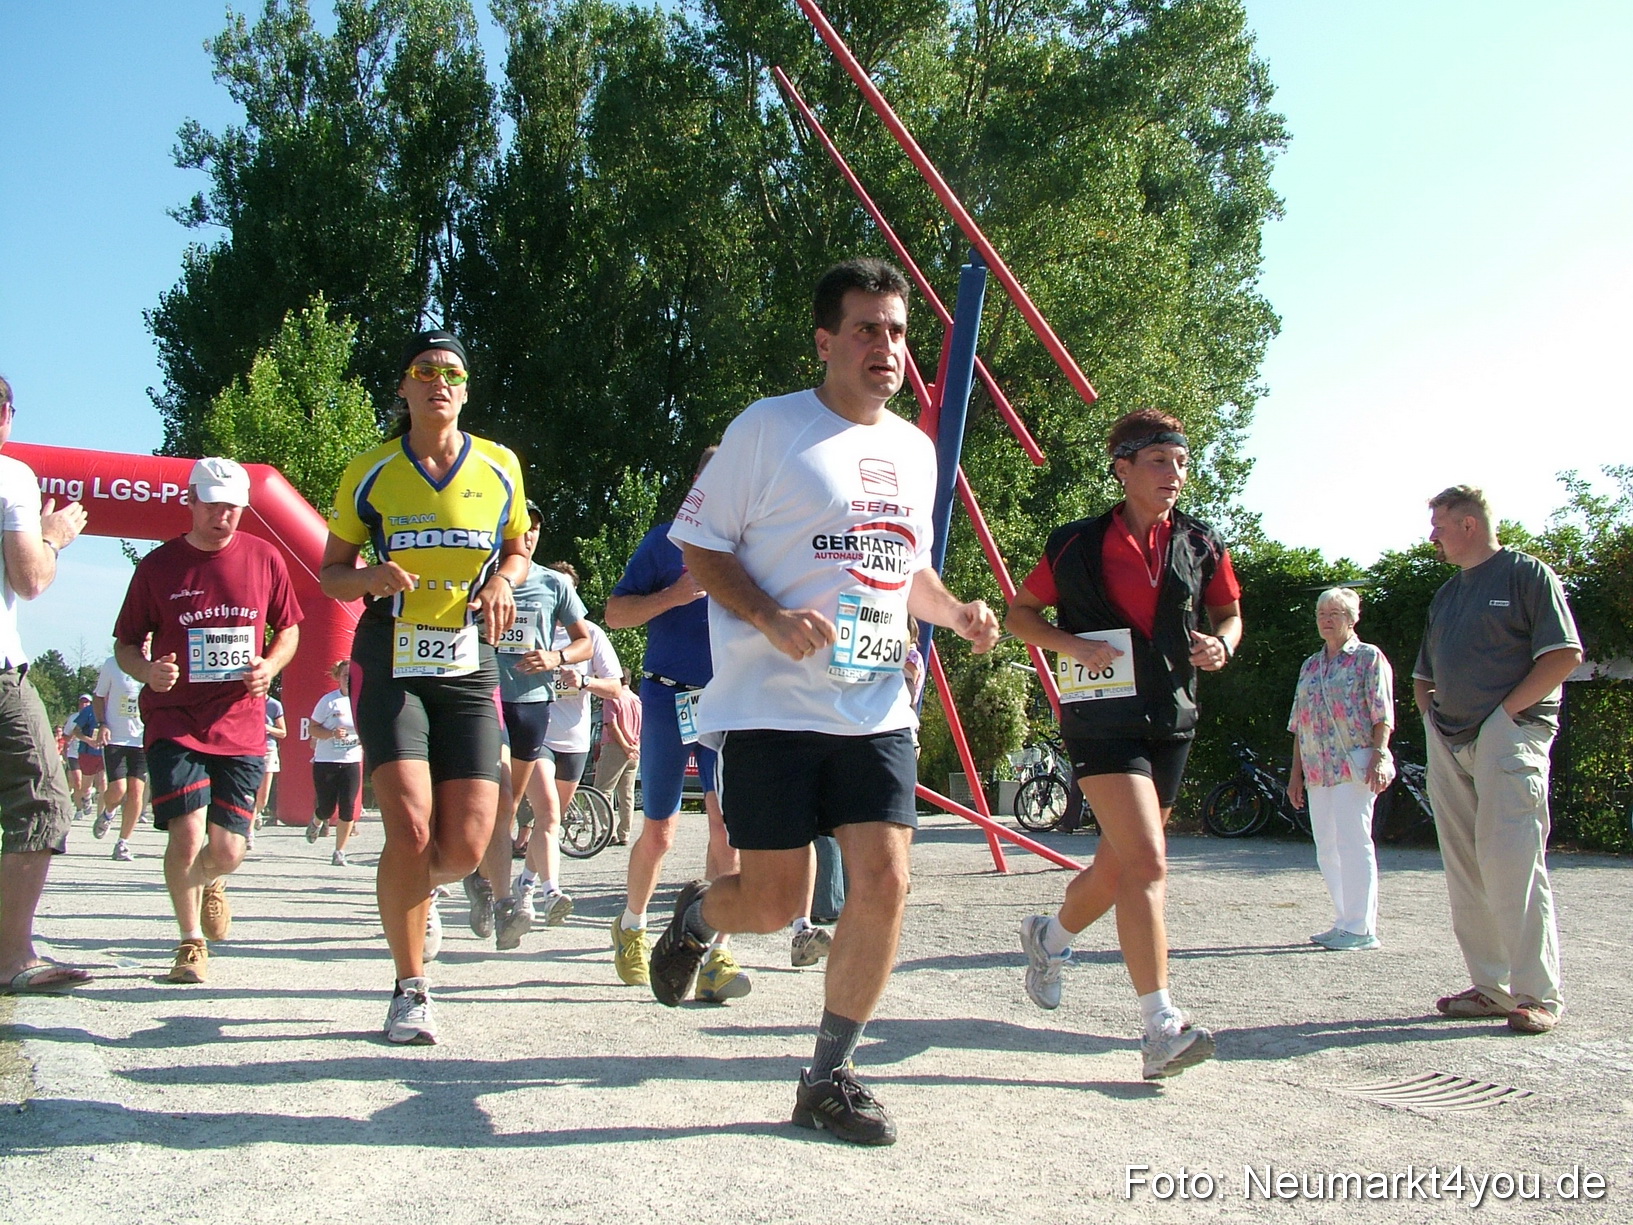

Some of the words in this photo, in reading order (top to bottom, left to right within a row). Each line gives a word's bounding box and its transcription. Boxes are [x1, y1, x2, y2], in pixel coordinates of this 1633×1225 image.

[851, 500, 914, 517] SEAT
[389, 513, 437, 526] TEAM
[388, 528, 495, 552] BOCK
[814, 552, 865, 560] AUTOHAUS
[179, 603, 259, 626] Gasthaus
[860, 606, 893, 625] Dieter
[205, 633, 250, 645] Wolfgang
[399, 636, 409, 647] D
[417, 639, 457, 661] 821
[841, 626, 850, 640] D
[856, 635, 902, 663] 2450
[193, 648, 201, 658] D
[207, 650, 251, 667] 3365
[1060, 661, 1068, 672] D
